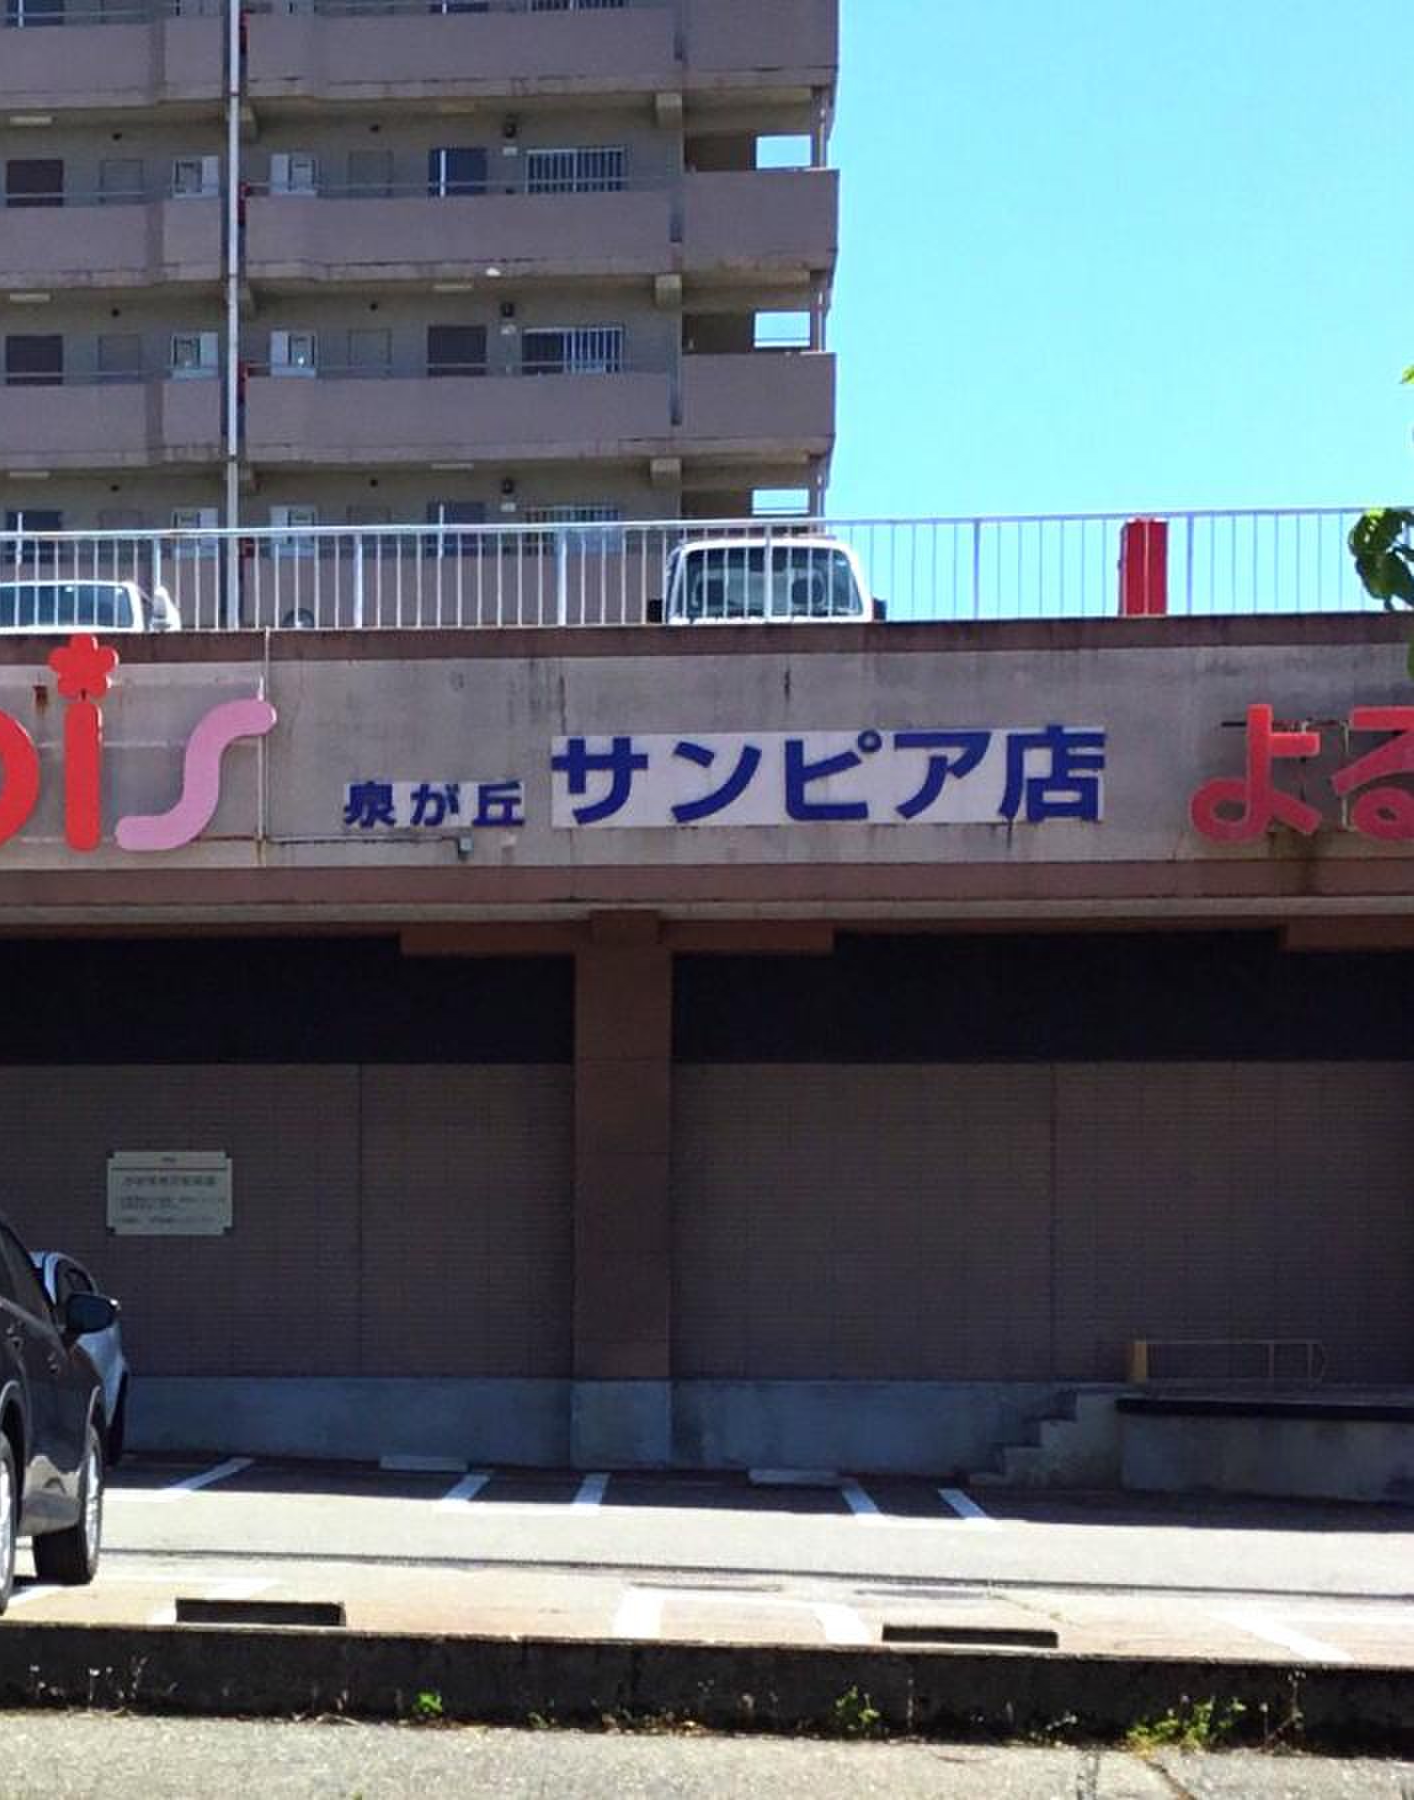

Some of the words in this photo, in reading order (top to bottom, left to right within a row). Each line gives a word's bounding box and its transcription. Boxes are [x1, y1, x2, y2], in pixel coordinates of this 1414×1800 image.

[343, 780, 526, 828] 泉が丘
[551, 724, 1106, 826] サンピア店
